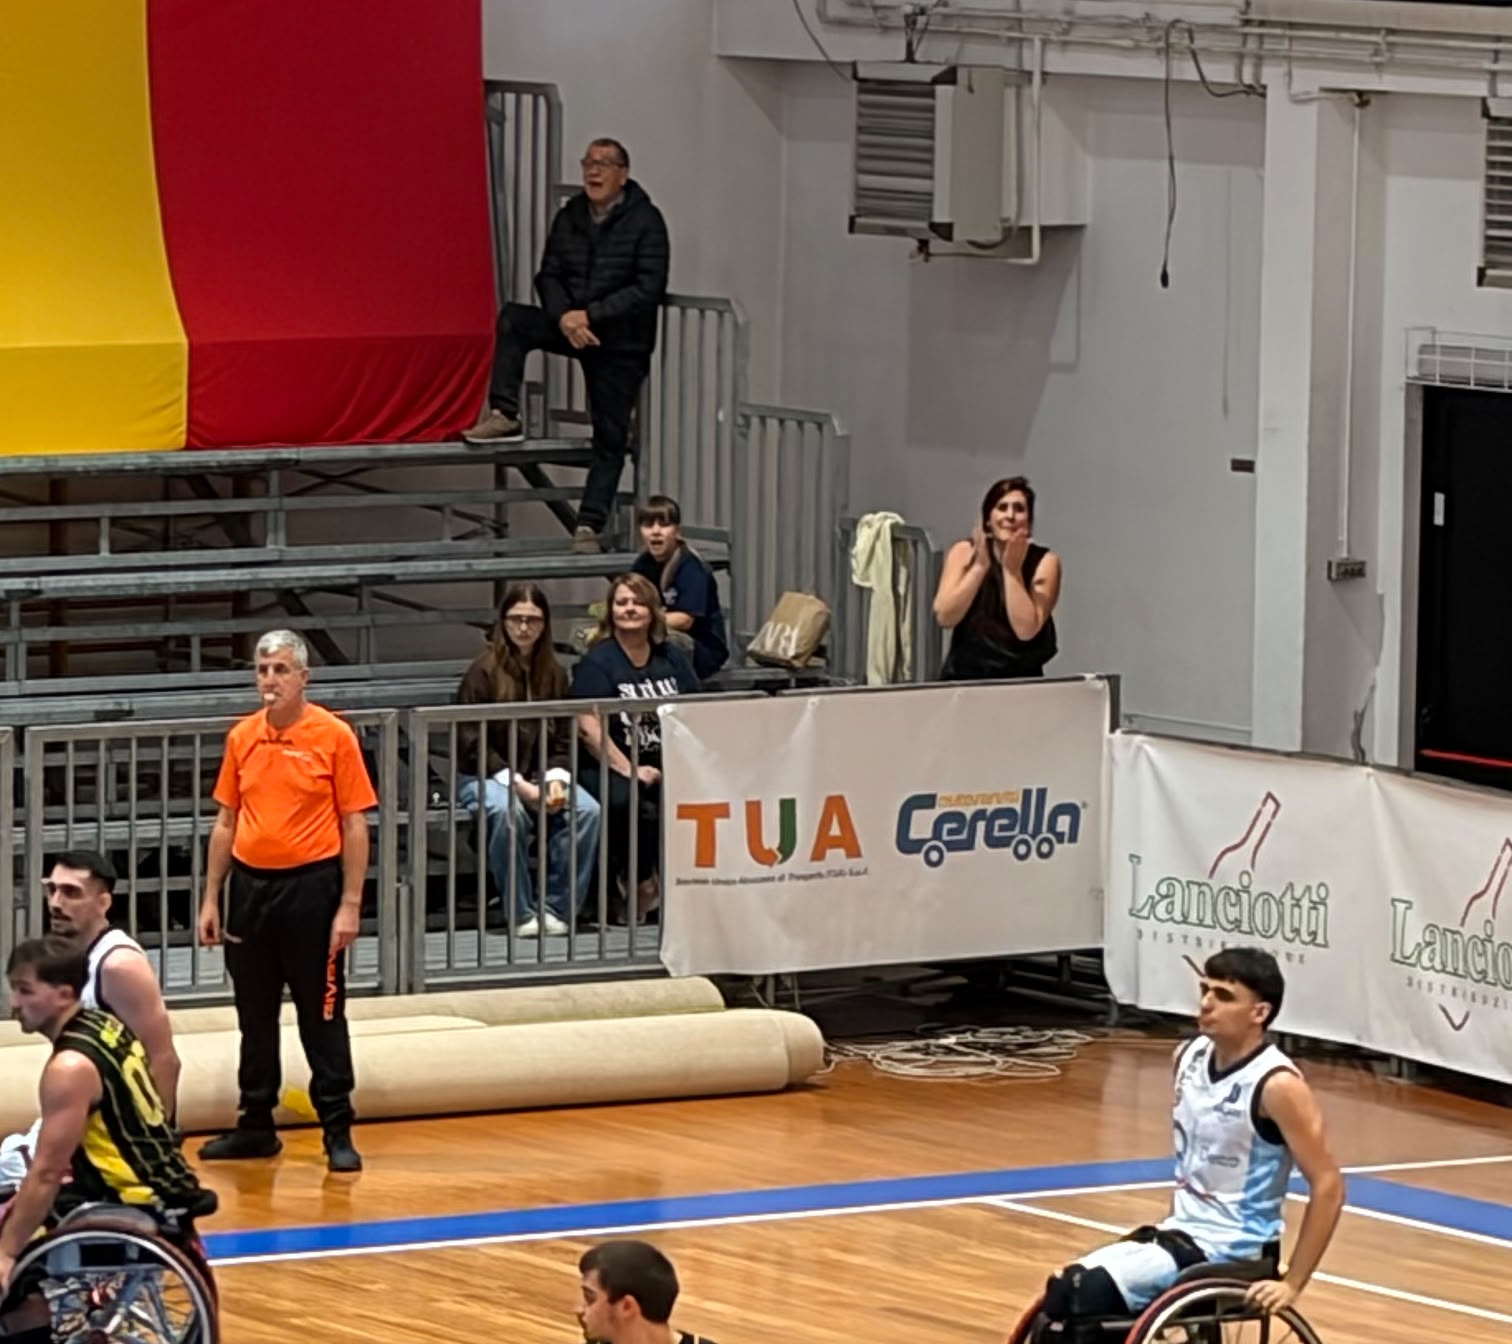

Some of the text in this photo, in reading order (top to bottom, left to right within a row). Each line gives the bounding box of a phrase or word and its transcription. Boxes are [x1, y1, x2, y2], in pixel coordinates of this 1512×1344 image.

[676, 794, 863, 869] TUA
[895, 787, 1082, 868] Cerella
[1128, 853, 1330, 949] Lanciotti
